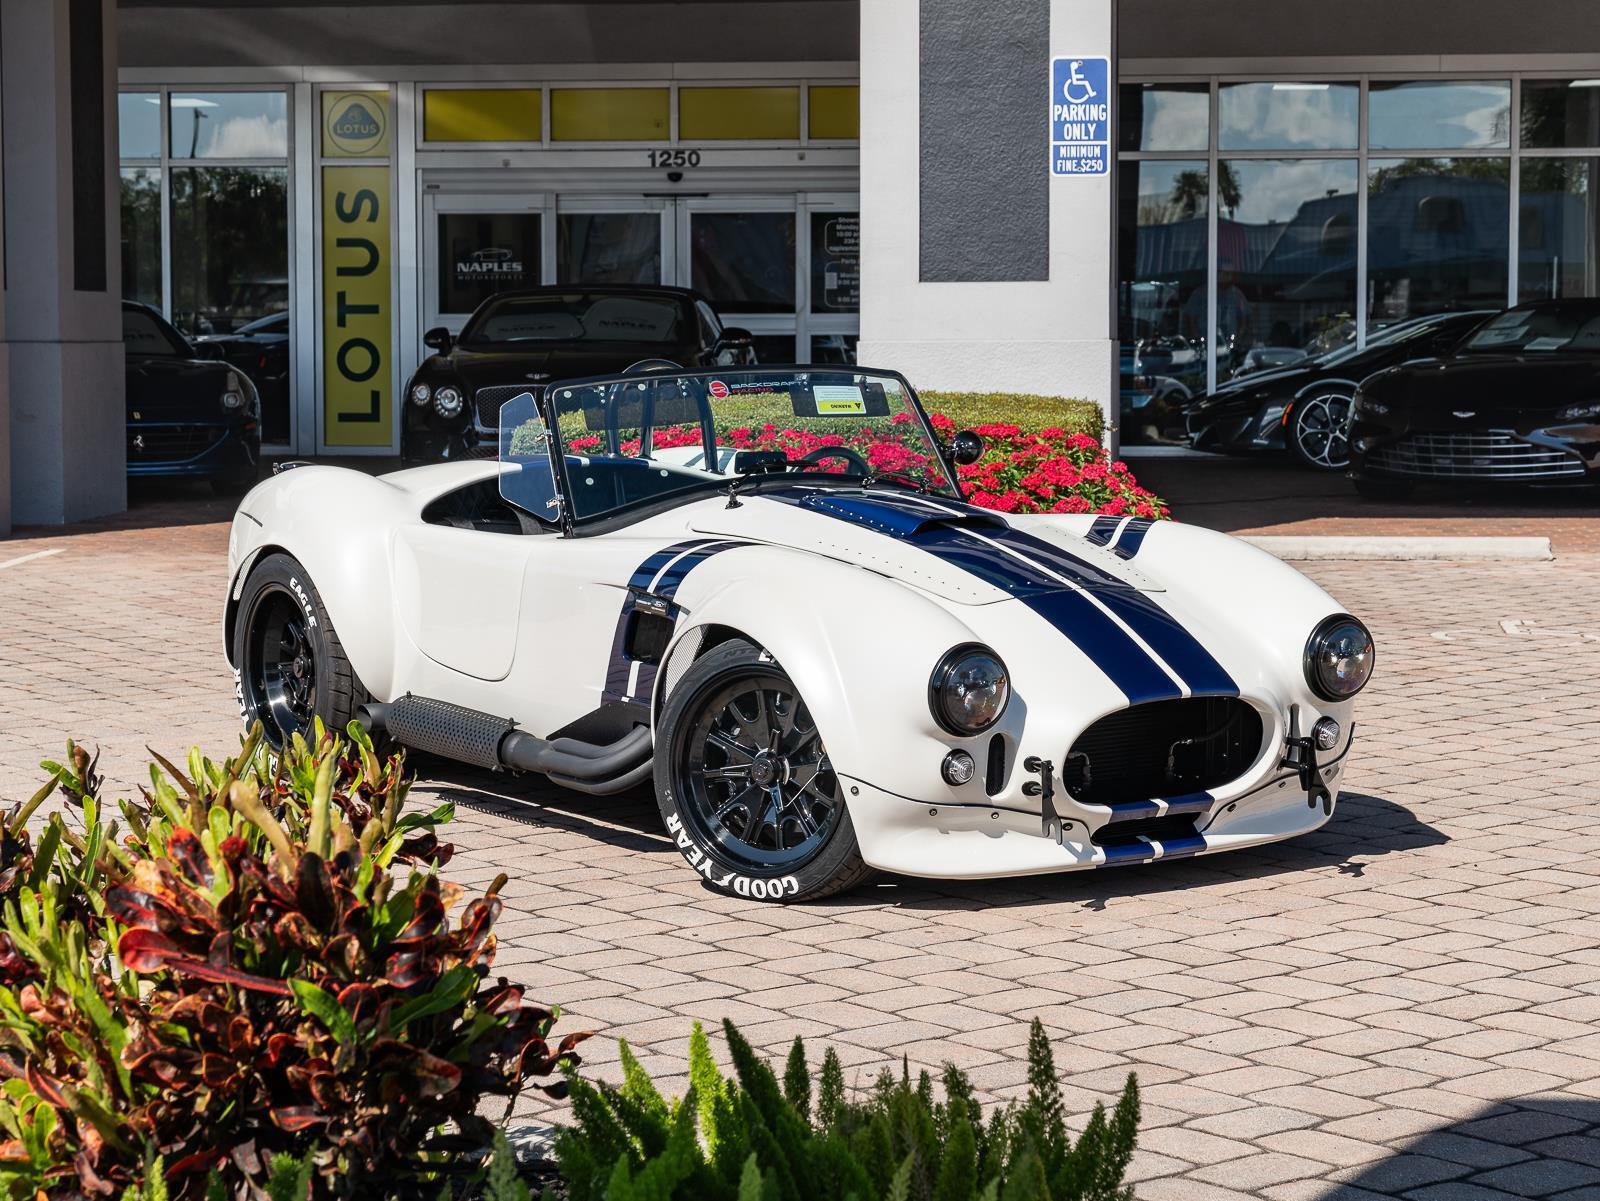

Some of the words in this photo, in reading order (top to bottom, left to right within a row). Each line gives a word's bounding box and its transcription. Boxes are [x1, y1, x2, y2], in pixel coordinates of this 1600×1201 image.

[1054, 104, 1107, 121] PARKING
[336, 124, 377, 134] LOTUS
[1063, 123, 1097, 140] ONLY
[647, 150, 701, 168] 1250
[1059, 145, 1101, 158] MINIMUM
[1056, 159, 1077, 172] FINE
[1080, 158, 1104, 173] $250
[457, 262, 523, 272] NAPLES
[335, 188, 381, 423] LOTUS
[289, 576, 318, 628] EAGLE
[666, 812, 714, 879] YEAR
[733, 875, 800, 899] GOOD
